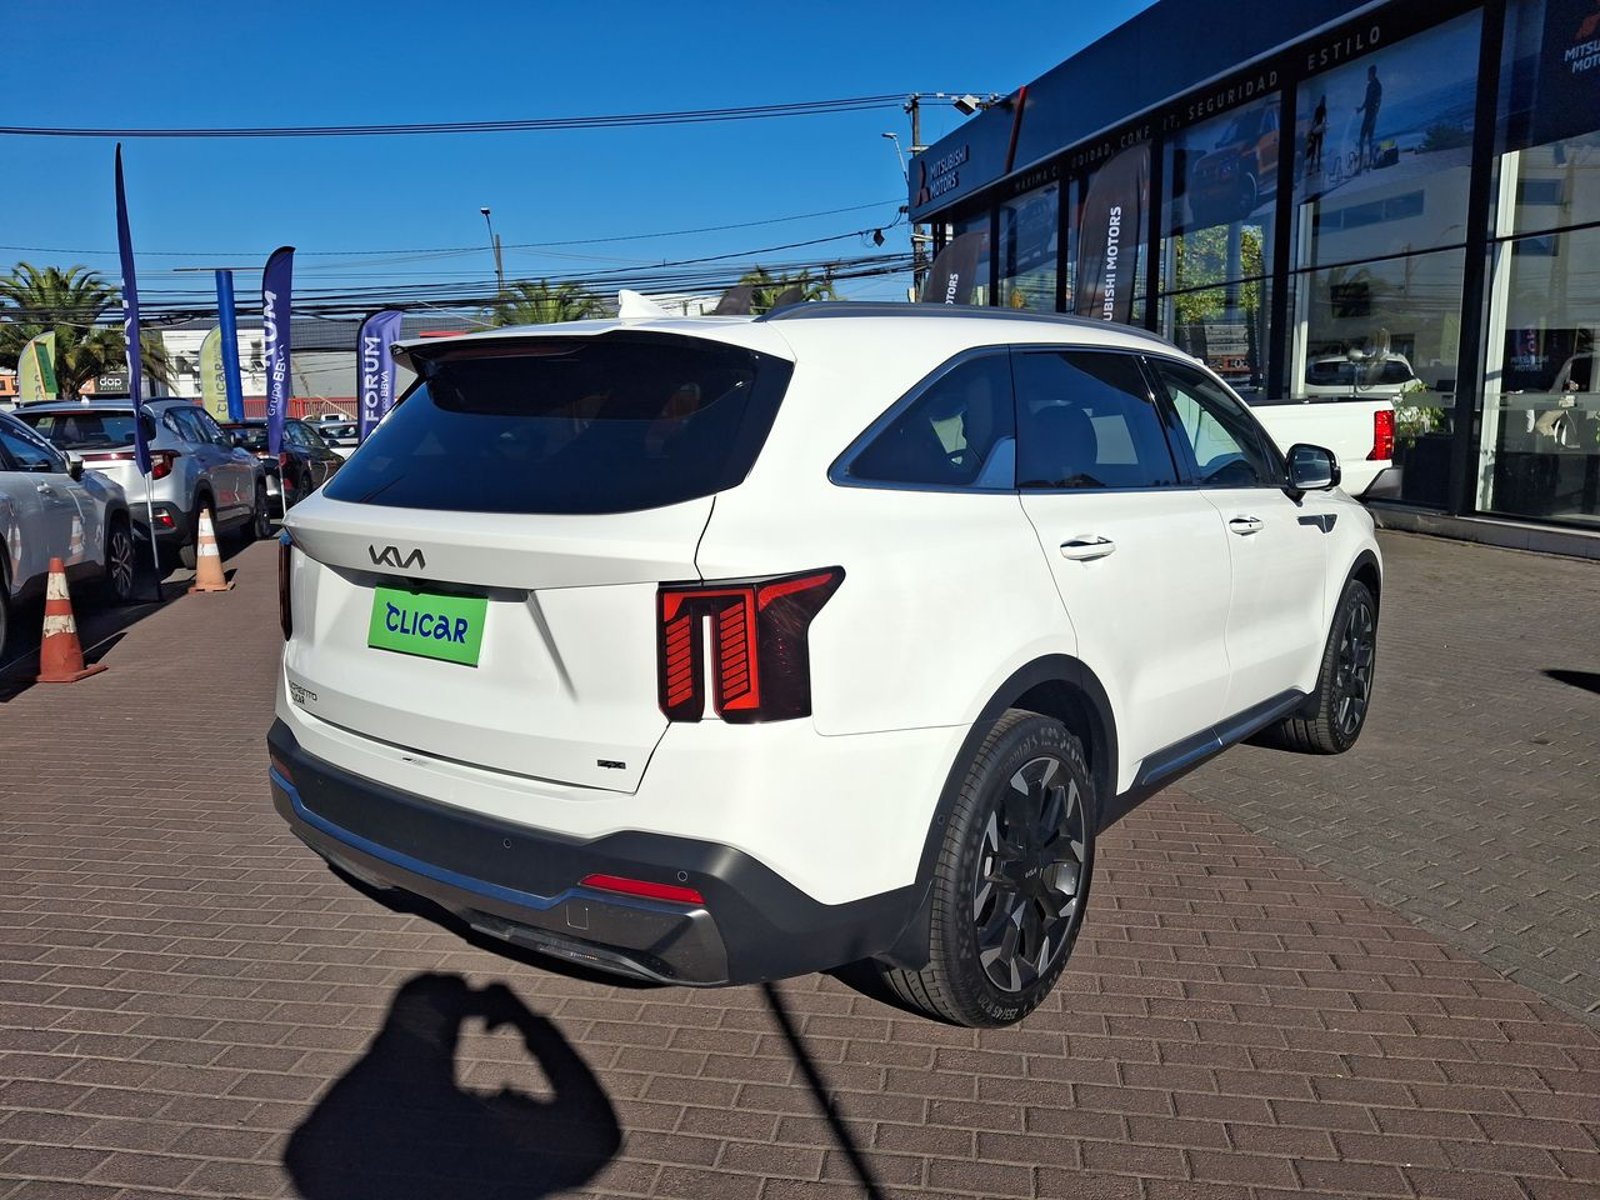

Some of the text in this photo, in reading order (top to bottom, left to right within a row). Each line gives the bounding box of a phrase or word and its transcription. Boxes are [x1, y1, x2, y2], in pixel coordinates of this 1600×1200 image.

[1188, 71, 1278, 120] SEGURIDAD
[1308, 26, 1381, 71] ESTILO
[1572, 53, 1600, 74] MOT
[930, 171, 959, 201] MOTORS
[1106, 206, 1121, 270] MOTORS
[365, 336, 381, 422] FORUM
[380, 370, 389, 397] BBVA
[268, 383, 282, 416] Grupo
[368, 544, 426, 570] KIA
